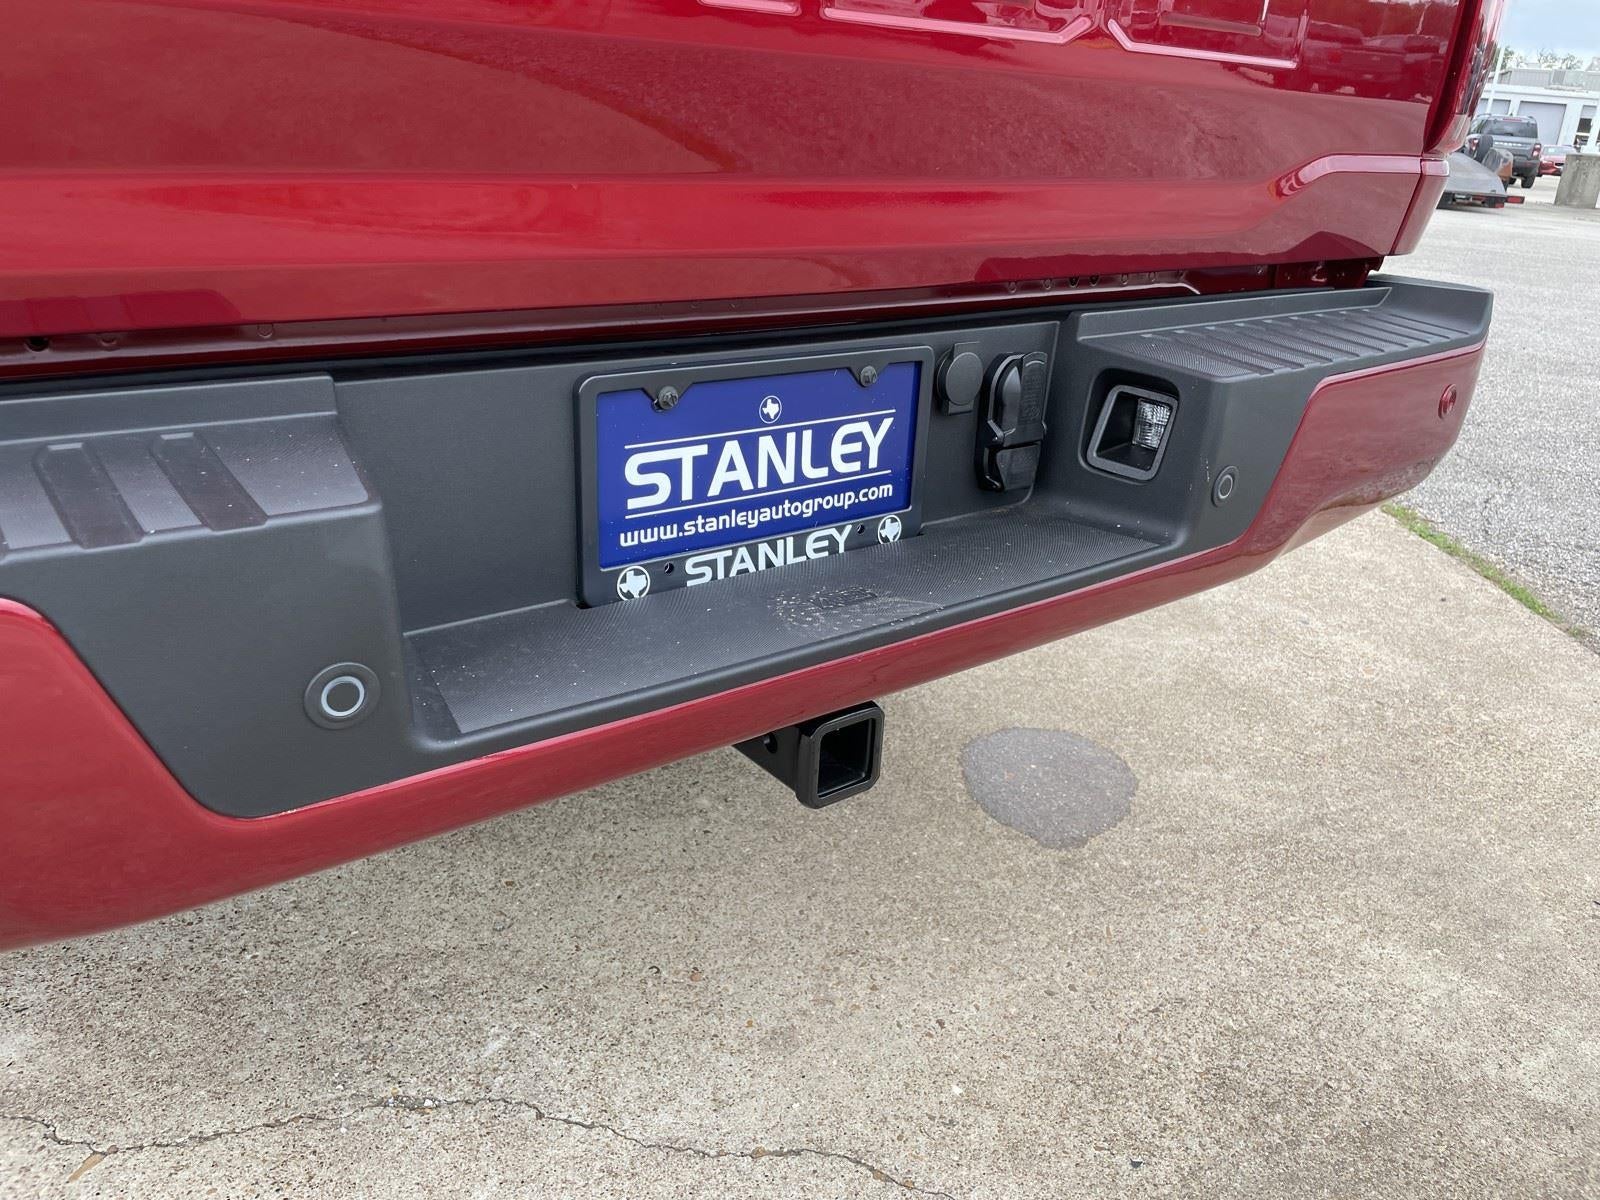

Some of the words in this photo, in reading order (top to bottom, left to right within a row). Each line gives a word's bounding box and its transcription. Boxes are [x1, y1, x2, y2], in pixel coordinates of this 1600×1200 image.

[624, 417, 894, 510] STANLEY
[619, 483, 893, 547] www.stanleyautogroup.com
[684, 524, 852, 587] STANLEY
